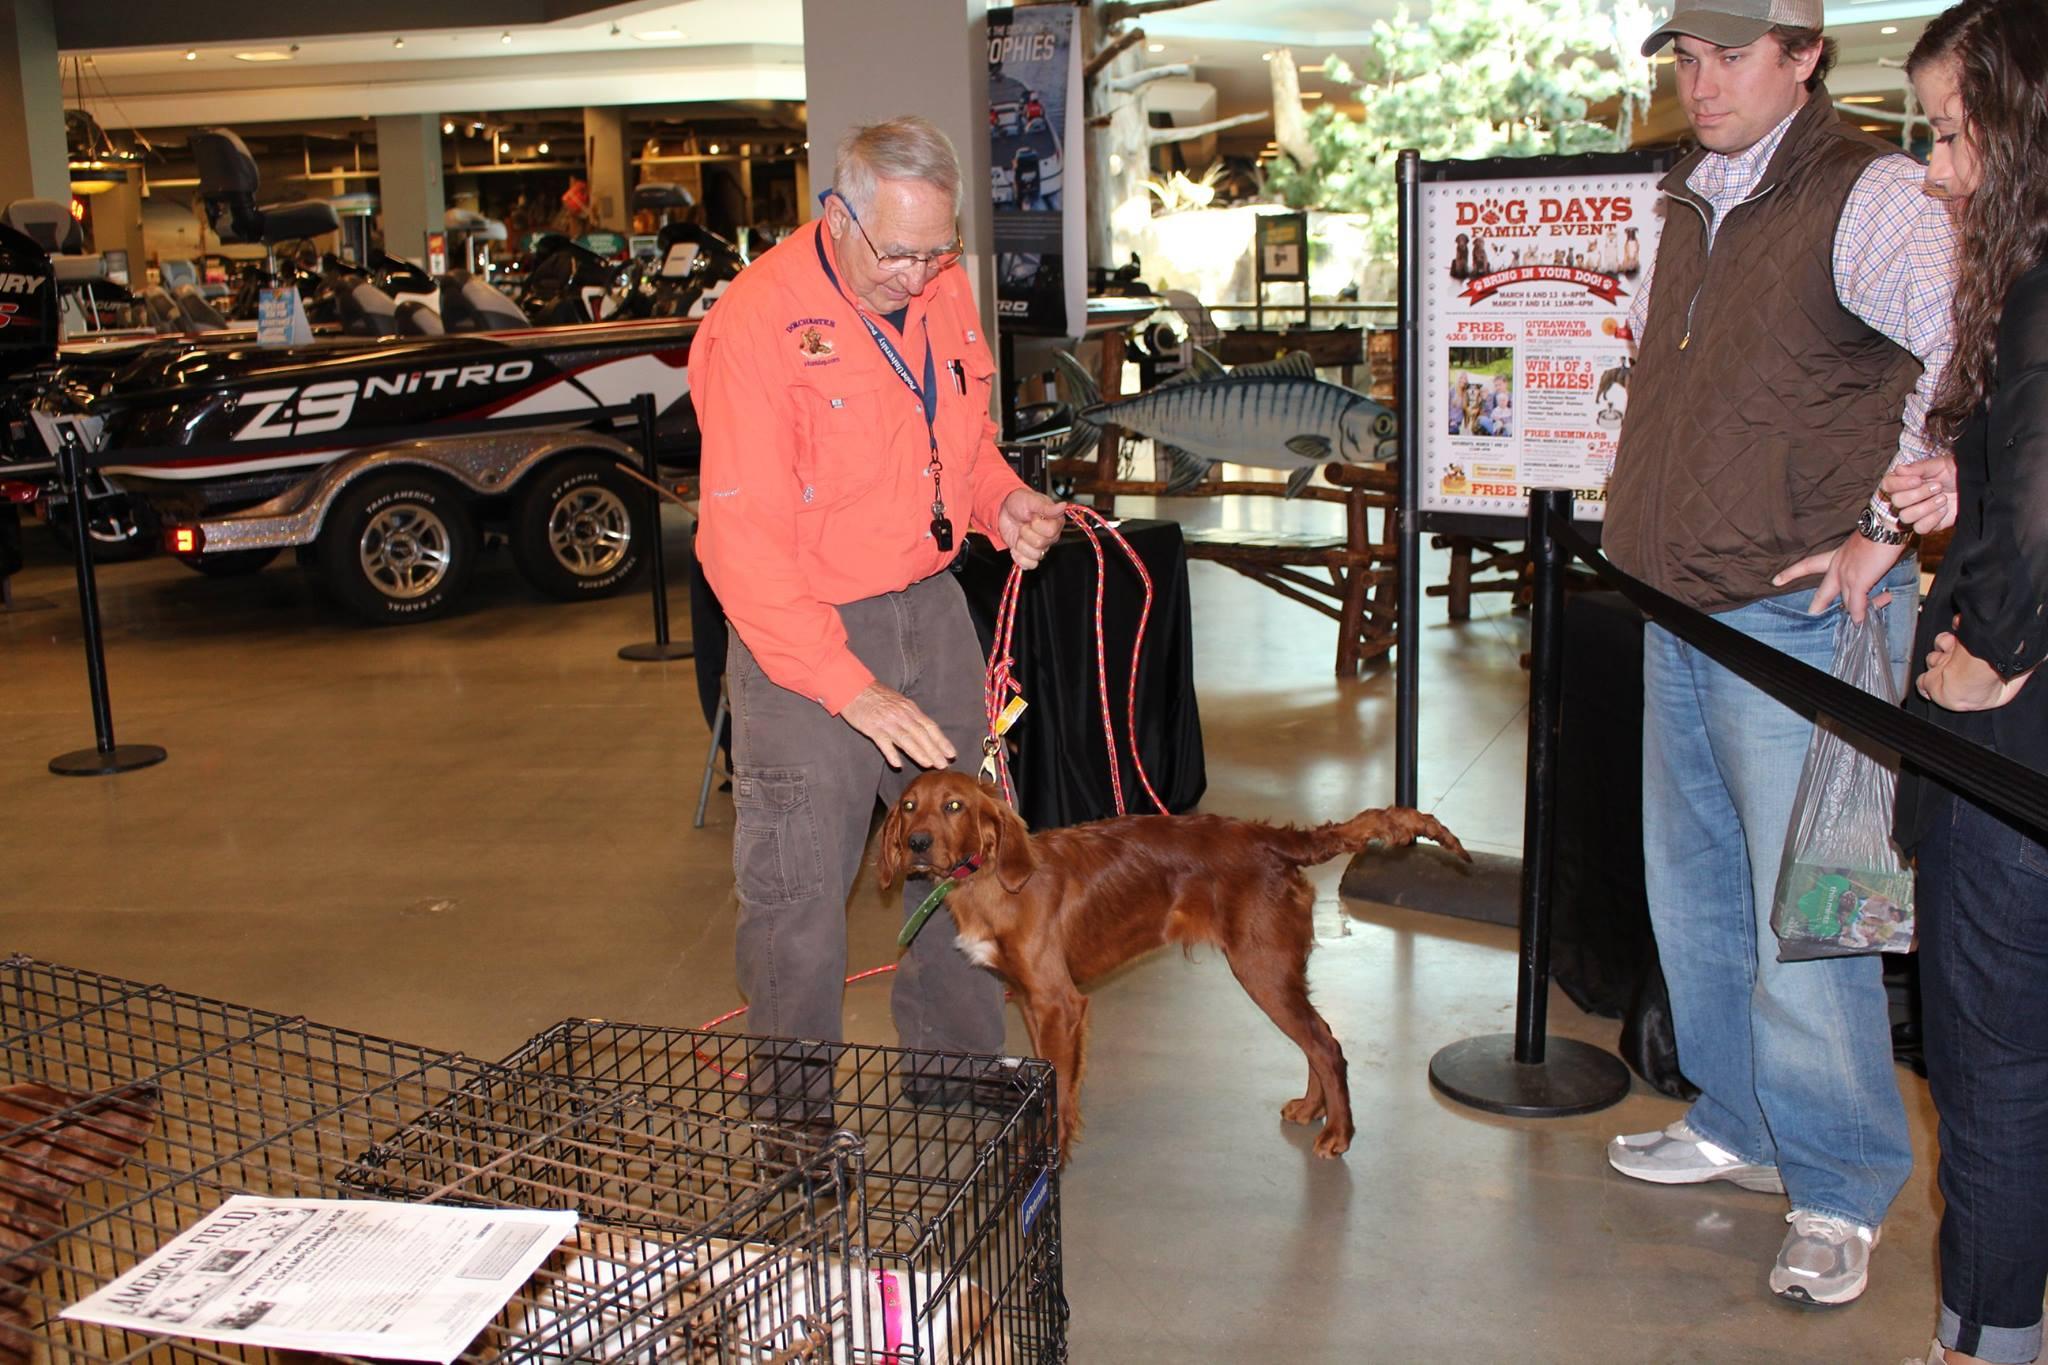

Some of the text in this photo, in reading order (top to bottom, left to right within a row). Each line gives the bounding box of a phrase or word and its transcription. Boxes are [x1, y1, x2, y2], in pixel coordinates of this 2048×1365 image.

[989, 33, 1056, 64] OPHIES
[1539, 197, 1633, 224] DAYS
[1472, 223, 1617, 238] FAMILY EVENT
[1482, 267, 1602, 287] BRING IN YOUR DOG!
[1457, 321, 1504, 333] FREE
[1525, 320, 1586, 329] GIVEAWAYS
[1472, 333, 1517, 341] PHOTO!
[1537, 329, 1592, 337] DRAWINGS
[878, 337, 904, 374] University
[1525, 360, 1551, 372] WIN
[1554, 361, 1560, 372] 1
[1564, 361, 1580, 372] OF
[1585, 361, 1592, 373] 3
[1525, 373, 1595, 390] PRIZES!
[1524, 429, 1607, 440] FREE SEMINARS
[1472, 483, 1517, 497] FREE
[1574, 488, 1609, 501] REA
[107, 1249, 194, 1313] AMERICAN
[189, 1210, 258, 1245] FIELD
